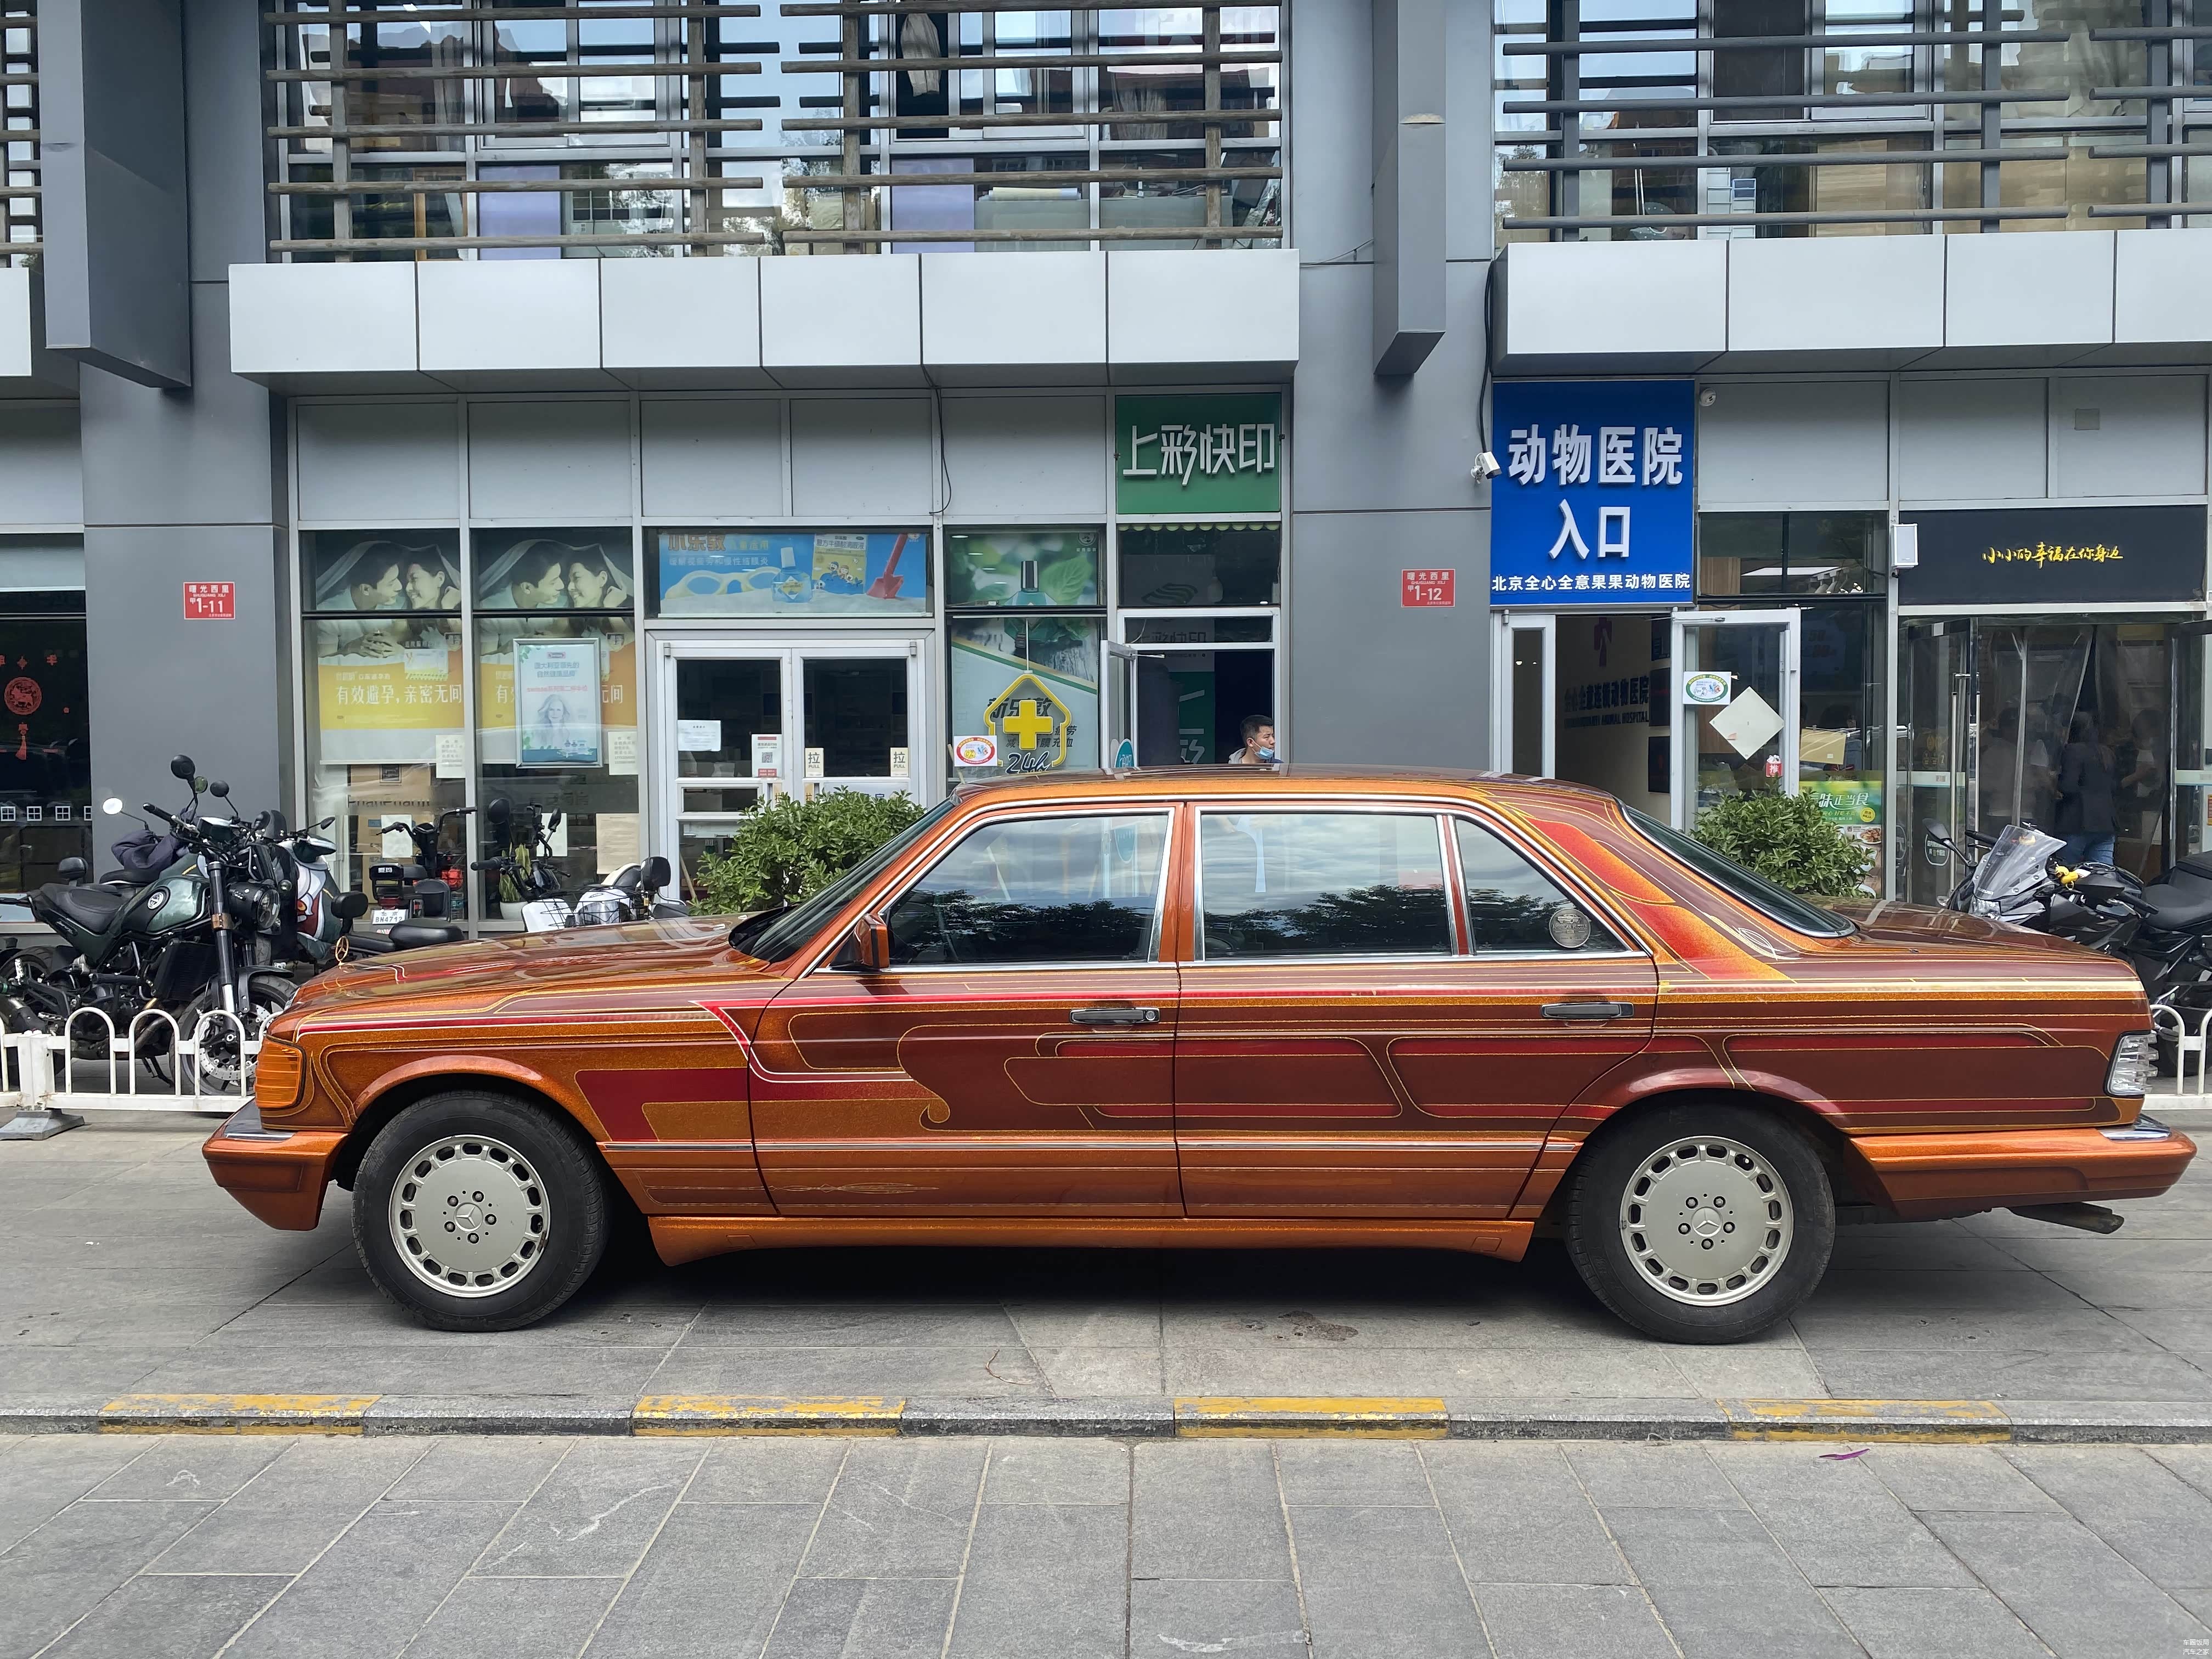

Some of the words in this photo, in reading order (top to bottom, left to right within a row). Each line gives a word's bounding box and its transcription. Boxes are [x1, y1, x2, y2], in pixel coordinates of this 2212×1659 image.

[1122, 423, 1275, 487] 上彩快印
[1508, 424, 1683, 487] 动物医院
[1548, 498, 1631, 560] 入口
[1982, 541, 2124, 569] 小小的幸福在你身边
[1492, 573, 1691, 592] 北京全心全意果果动物医院
[808, 752, 821, 764] 拉
[893, 751, 906, 764] 拉
[1770, 764, 1779, 774] 推
